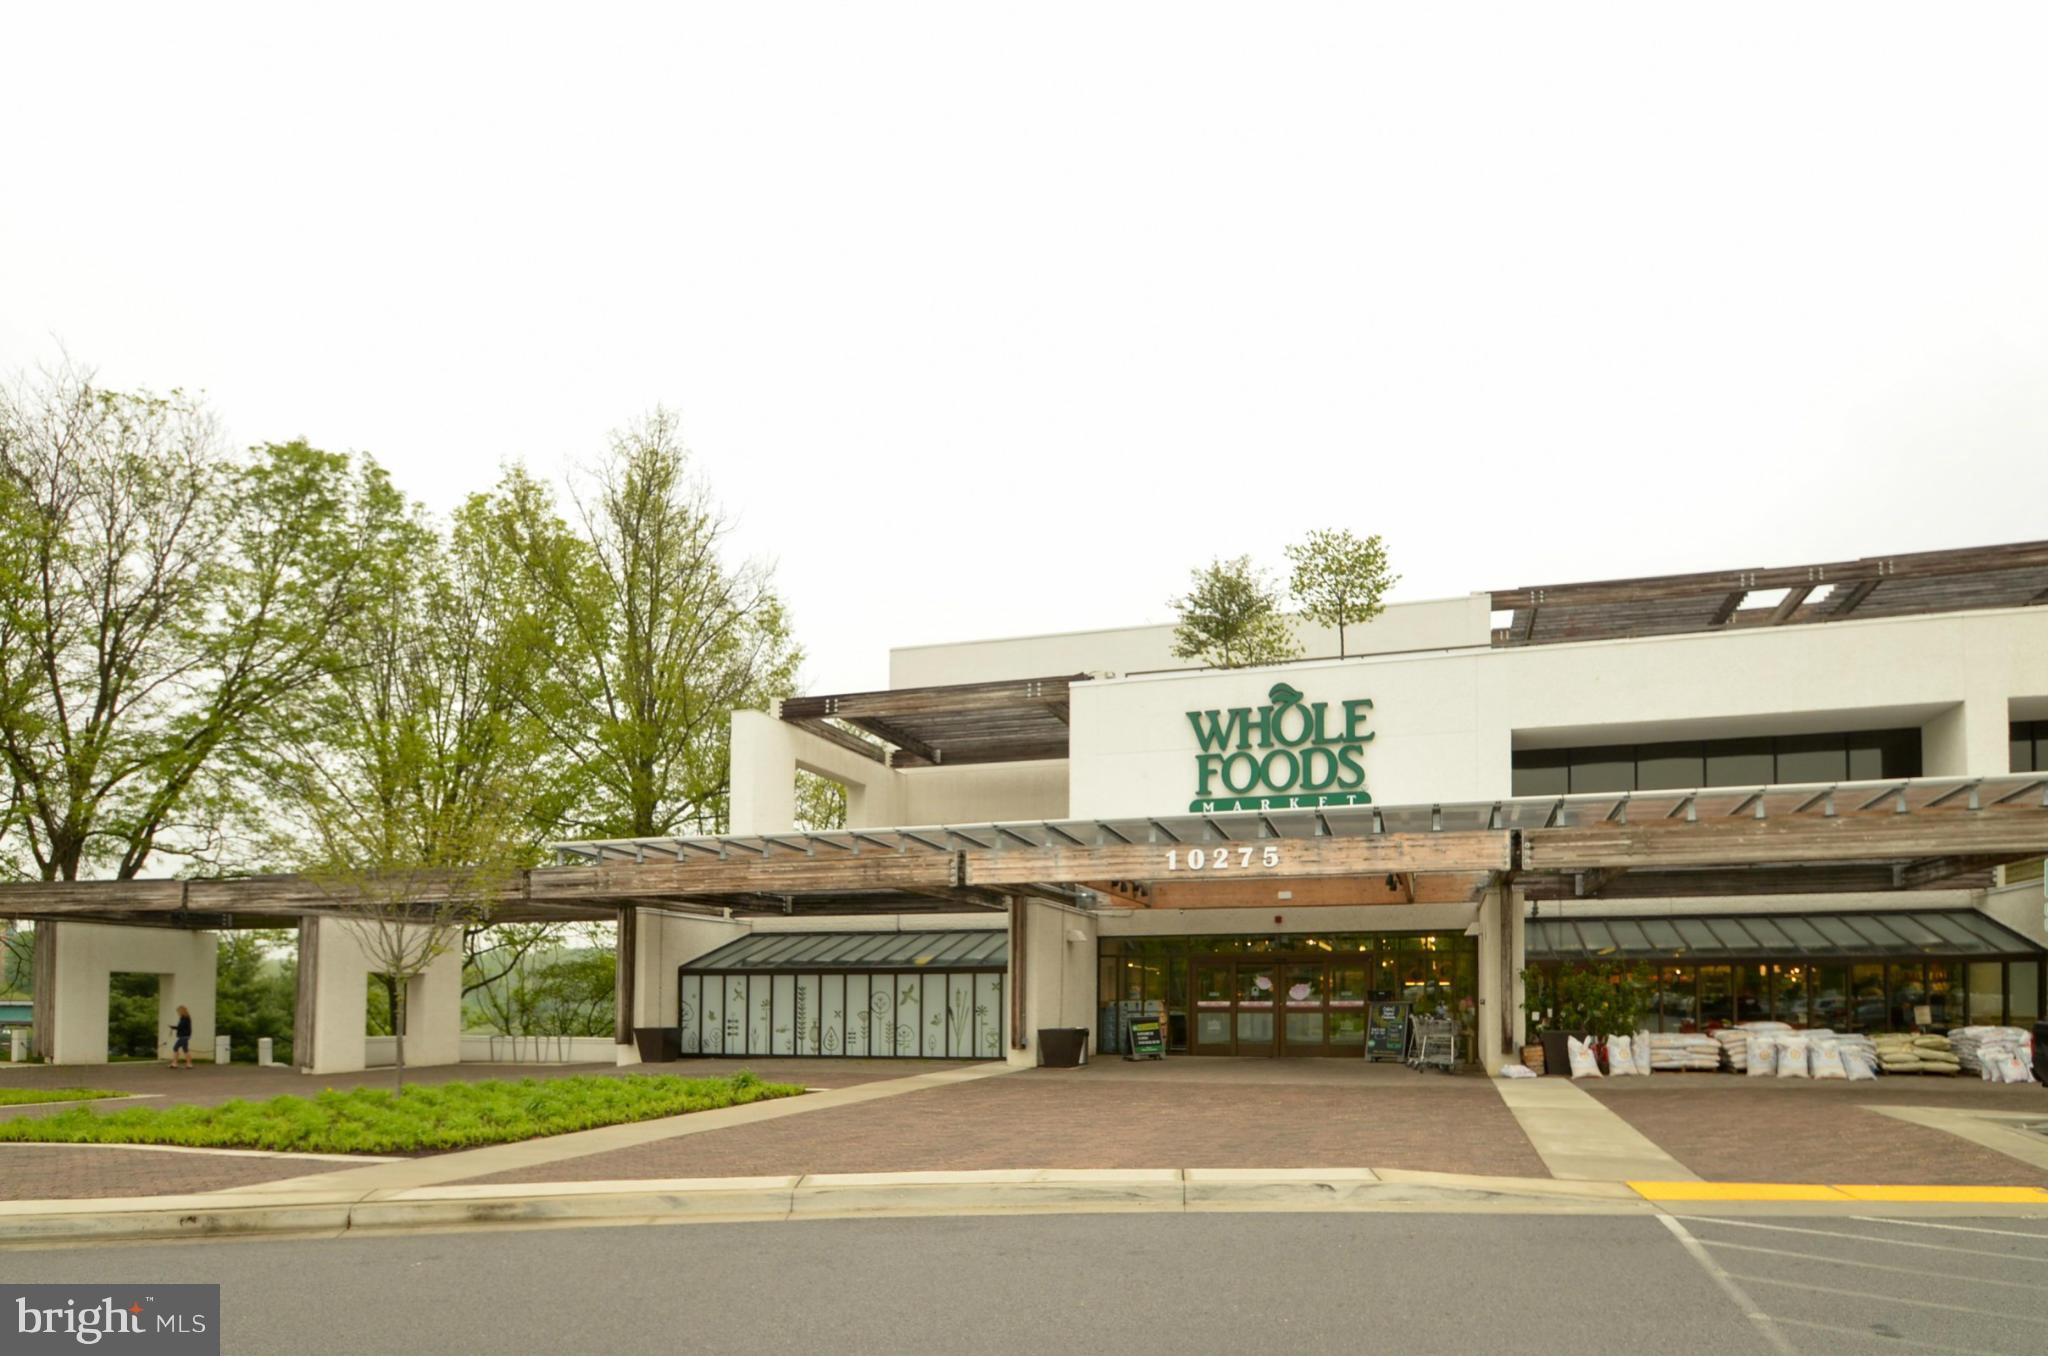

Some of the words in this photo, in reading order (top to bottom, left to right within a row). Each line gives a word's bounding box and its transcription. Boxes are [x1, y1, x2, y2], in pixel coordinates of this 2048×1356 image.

[1186, 698, 1375, 752] WHOLE
[1195, 744, 1366, 796] FOODS
[1202, 795, 1357, 813] MARKET
[1165, 846, 1280, 871] 10275
